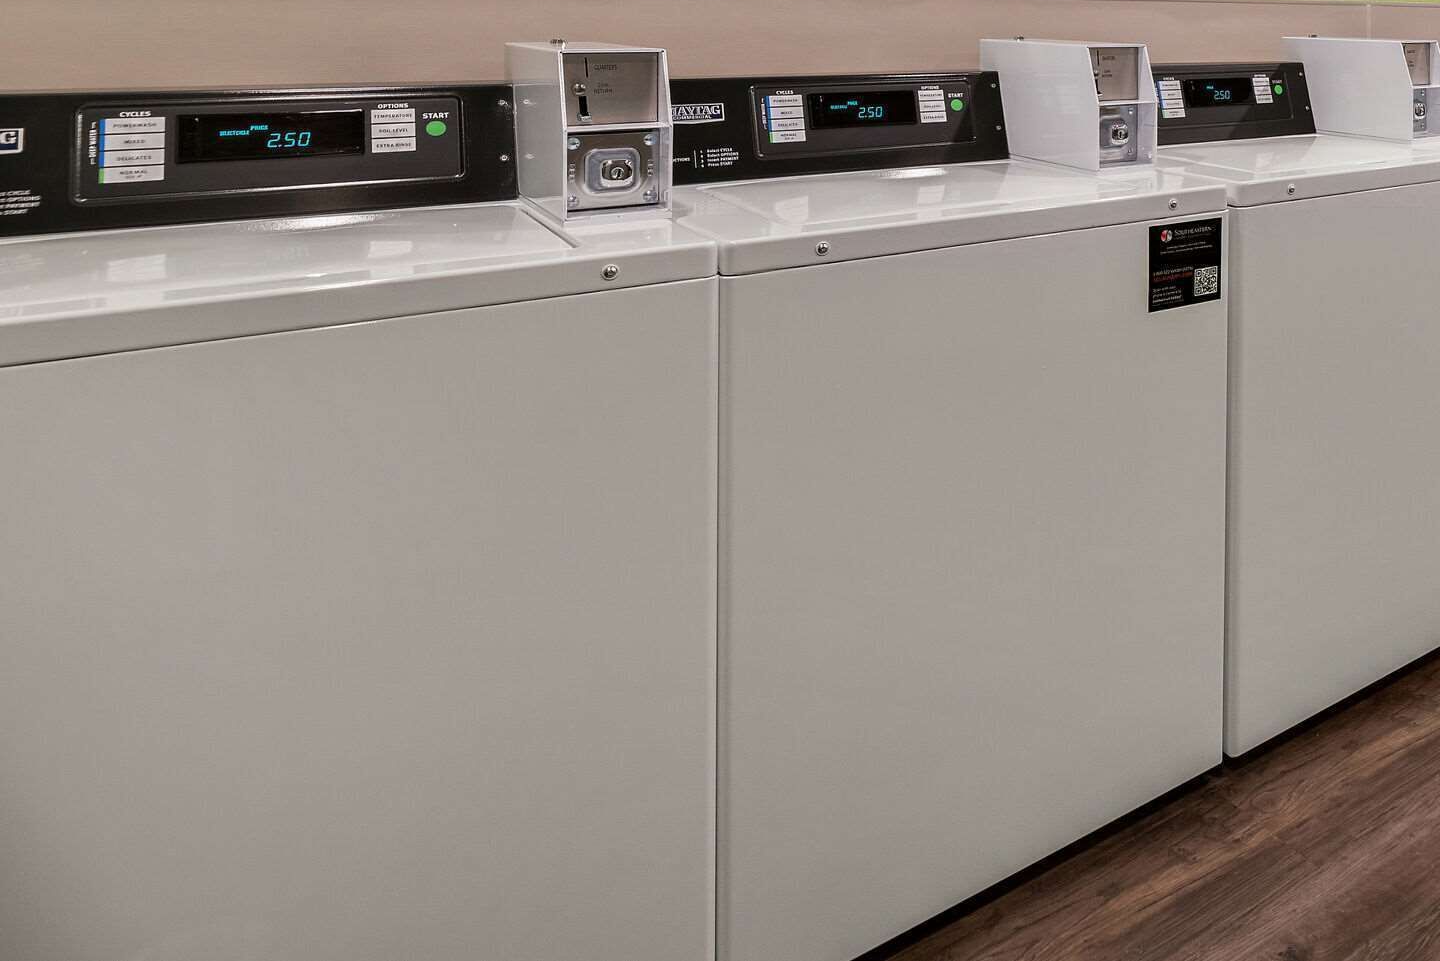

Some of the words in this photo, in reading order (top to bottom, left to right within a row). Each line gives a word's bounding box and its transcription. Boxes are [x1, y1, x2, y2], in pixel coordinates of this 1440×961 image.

[119, 110, 152, 118] CYCLES
[422, 112, 450, 120] START
[858, 106, 883, 118] 2.50
[267, 131, 311, 148] 2.50
